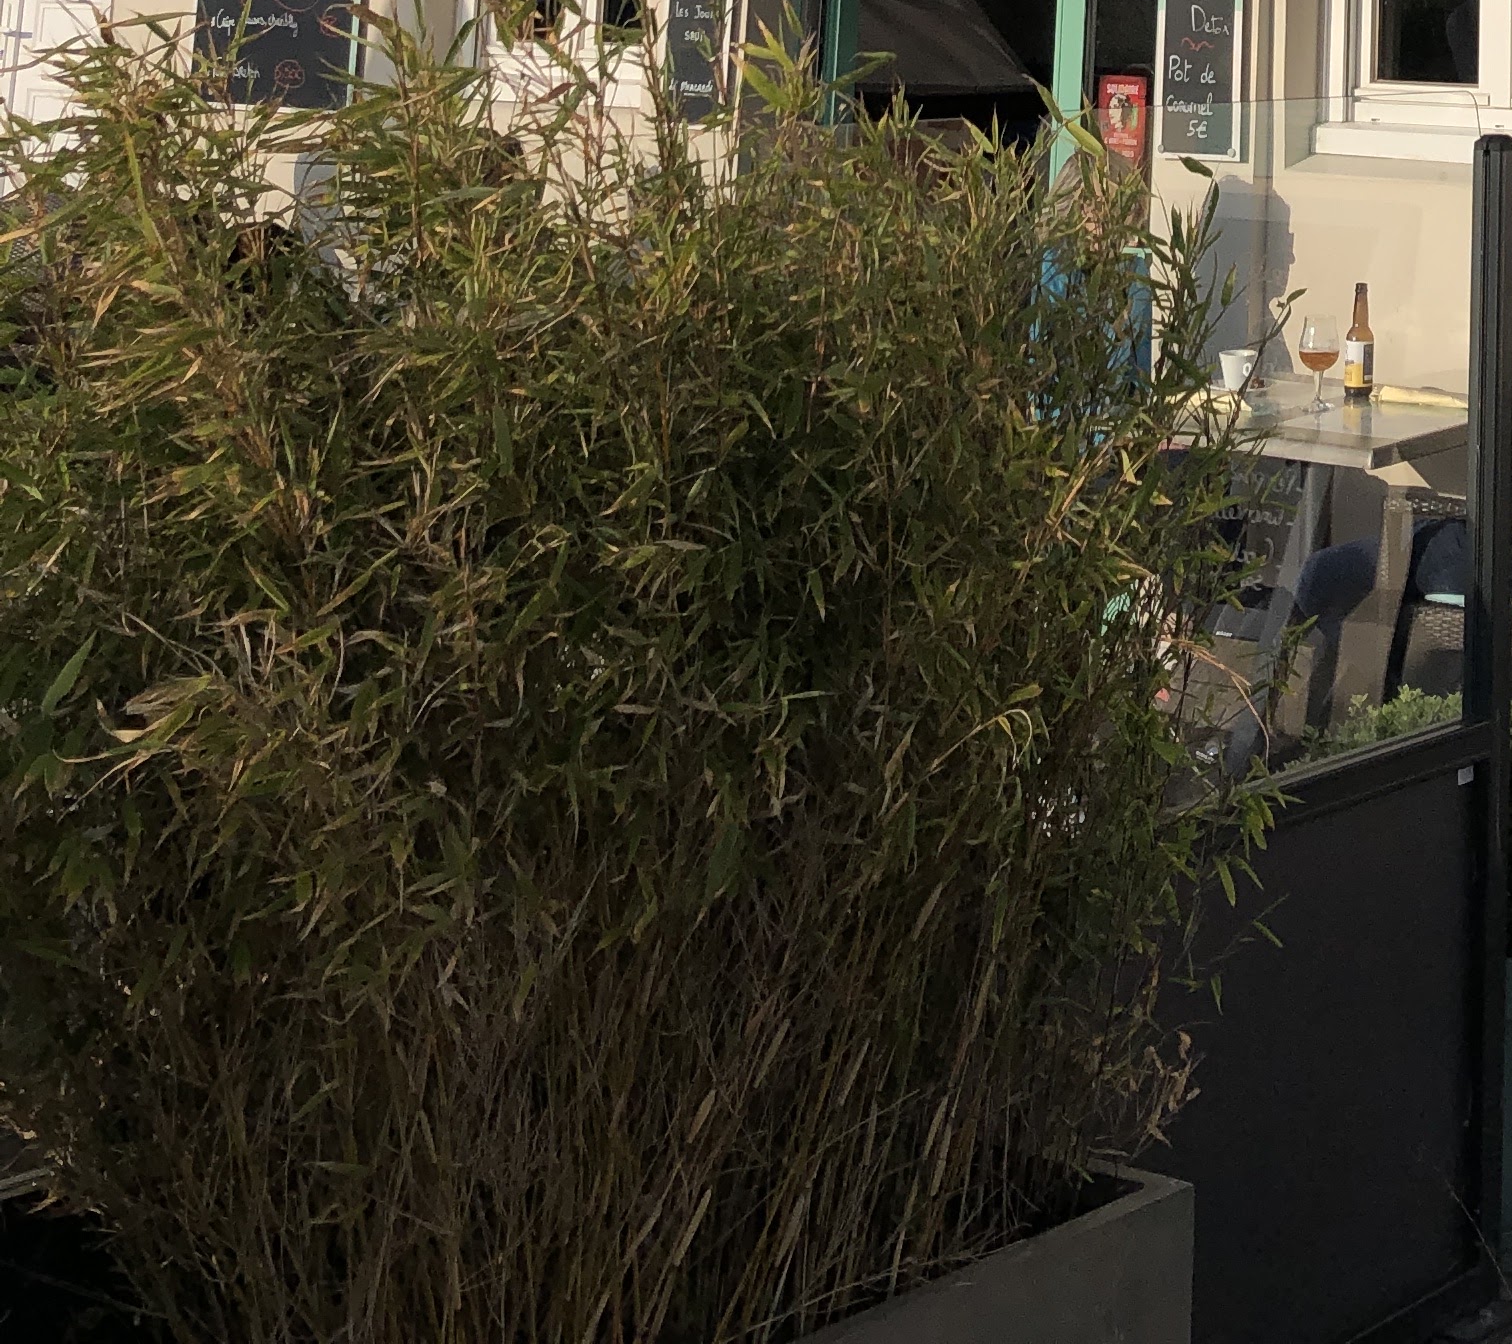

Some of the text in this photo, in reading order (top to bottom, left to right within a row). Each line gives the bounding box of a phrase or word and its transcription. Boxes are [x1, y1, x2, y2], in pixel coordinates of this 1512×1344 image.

[1168, 54, 1216, 84] Pot de
[1186, 119, 1208, 139] 5€
